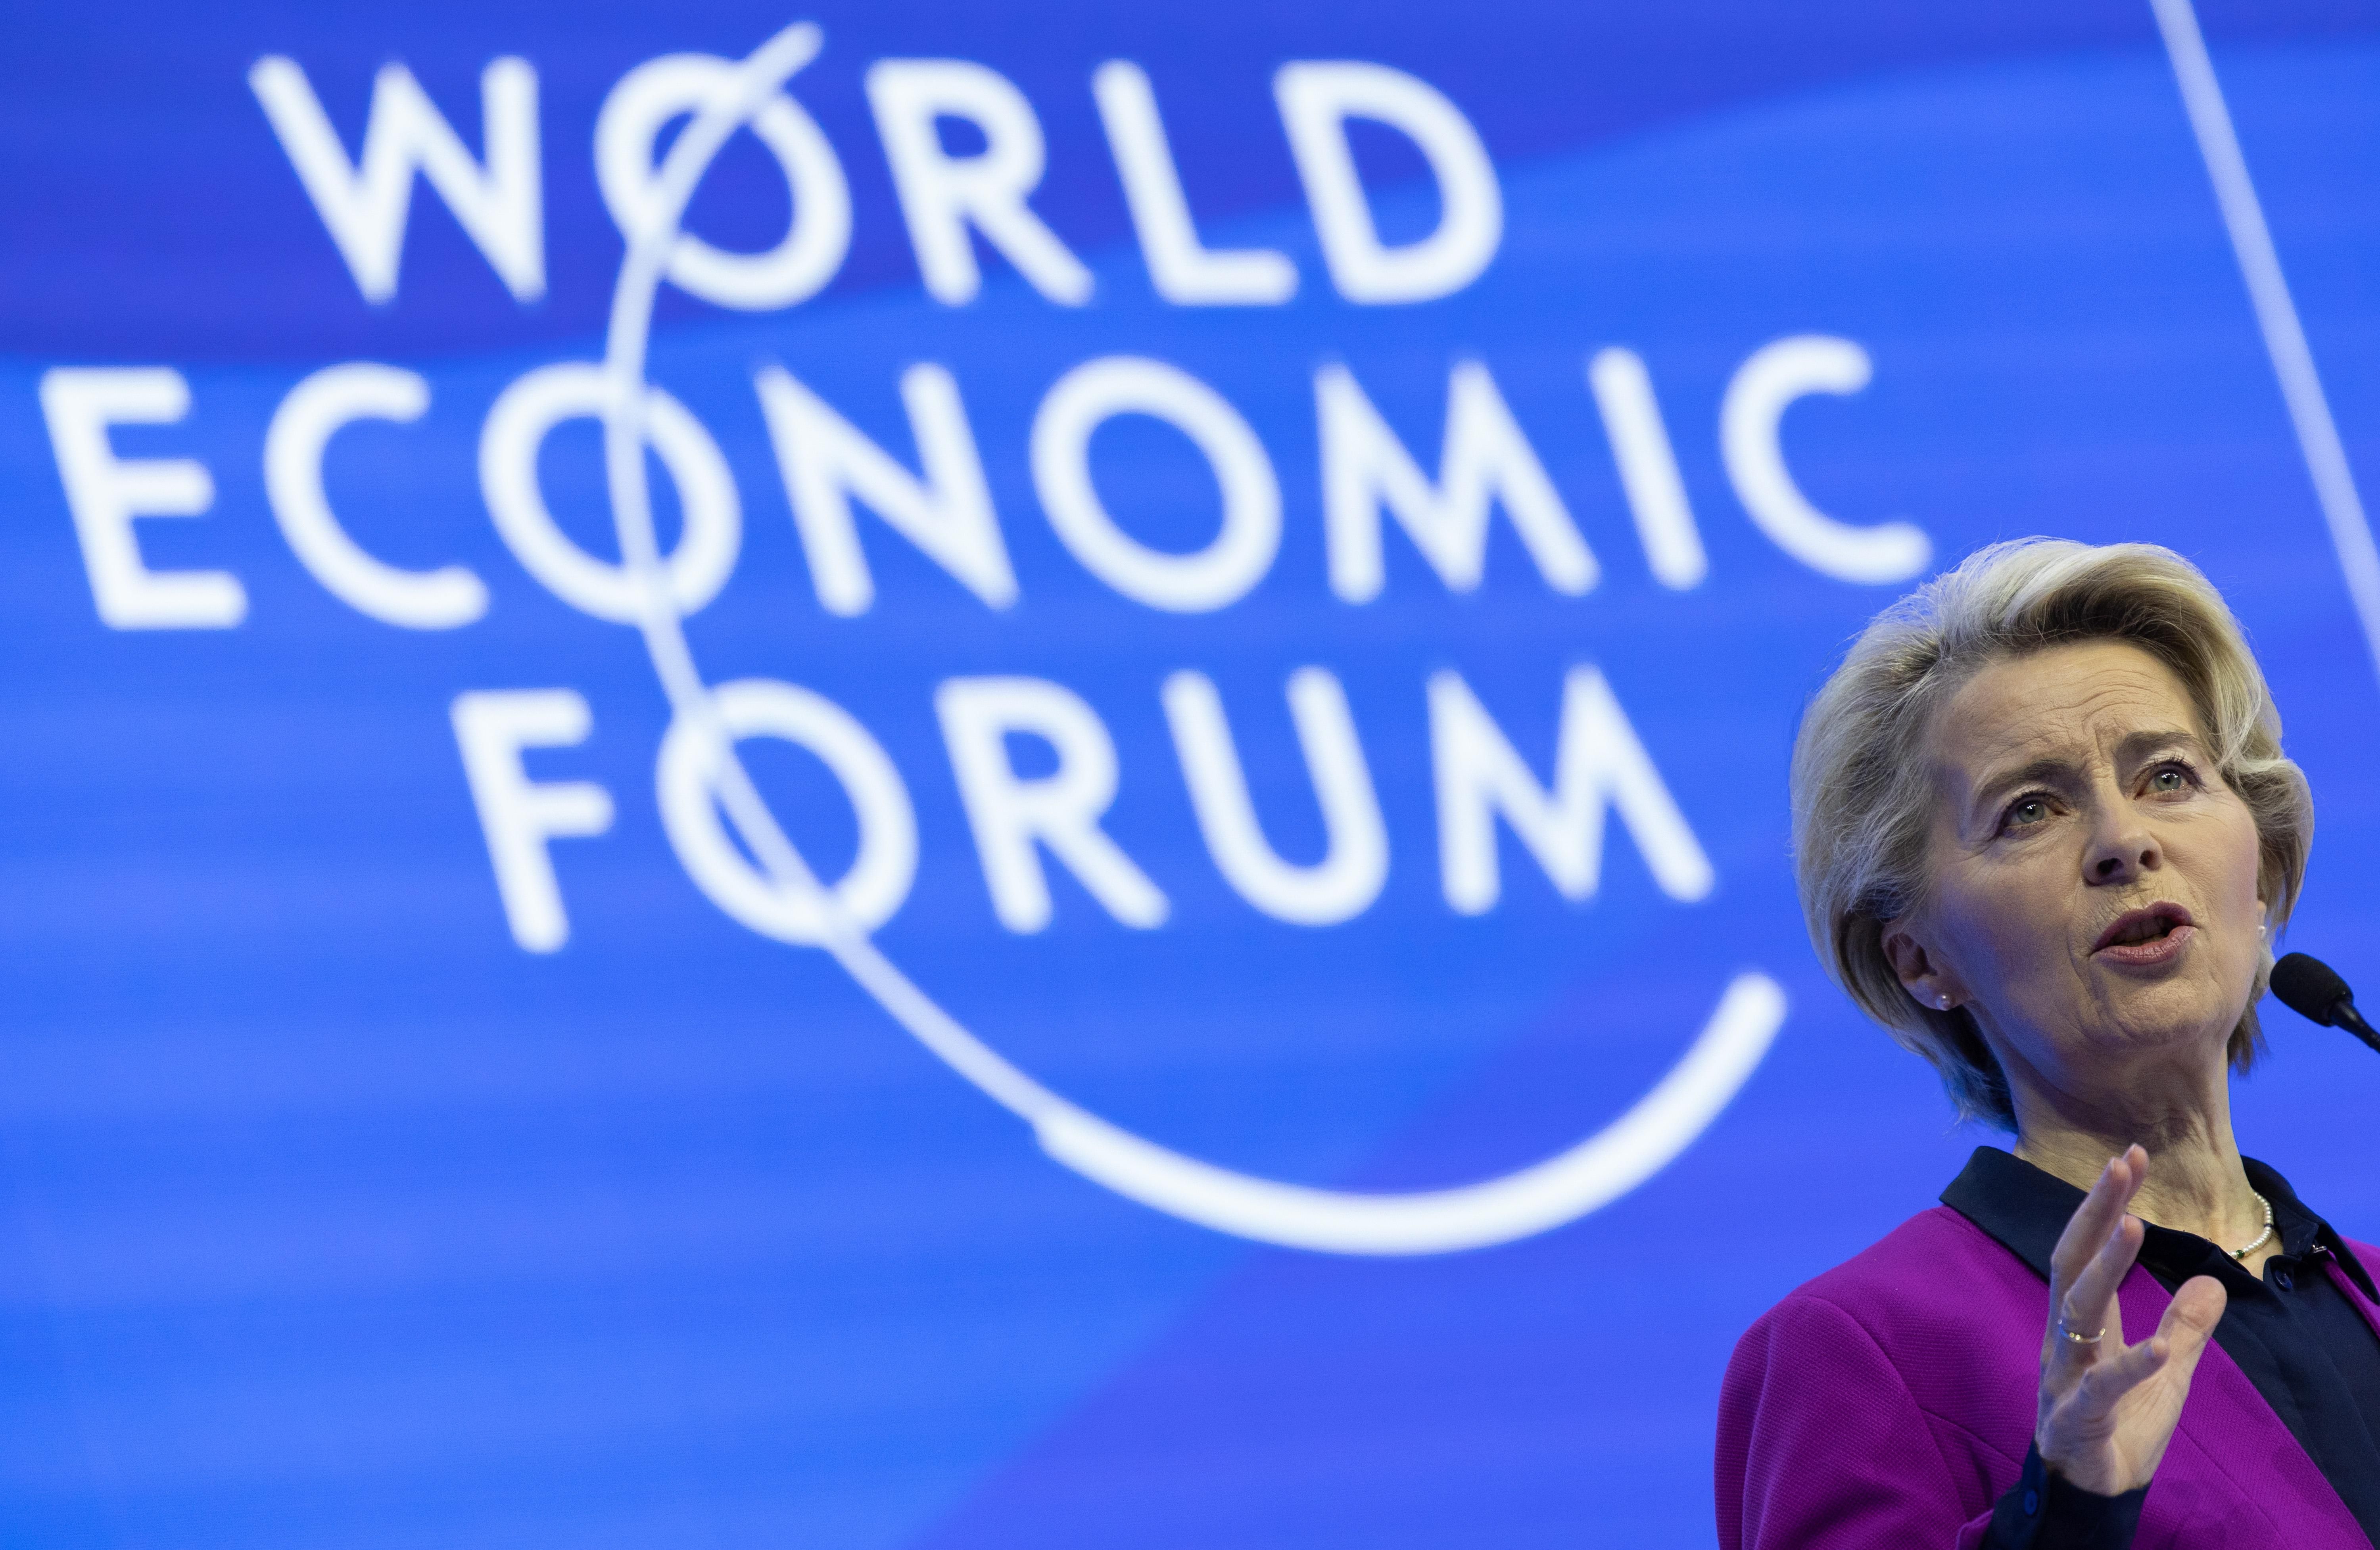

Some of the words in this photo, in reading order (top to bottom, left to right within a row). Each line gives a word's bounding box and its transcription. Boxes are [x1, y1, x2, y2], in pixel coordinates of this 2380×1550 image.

[251, 54, 1503, 310] WORLD
[40, 336, 1931, 630] ECONOMIC
[450, 668, 1714, 953] FORUM
